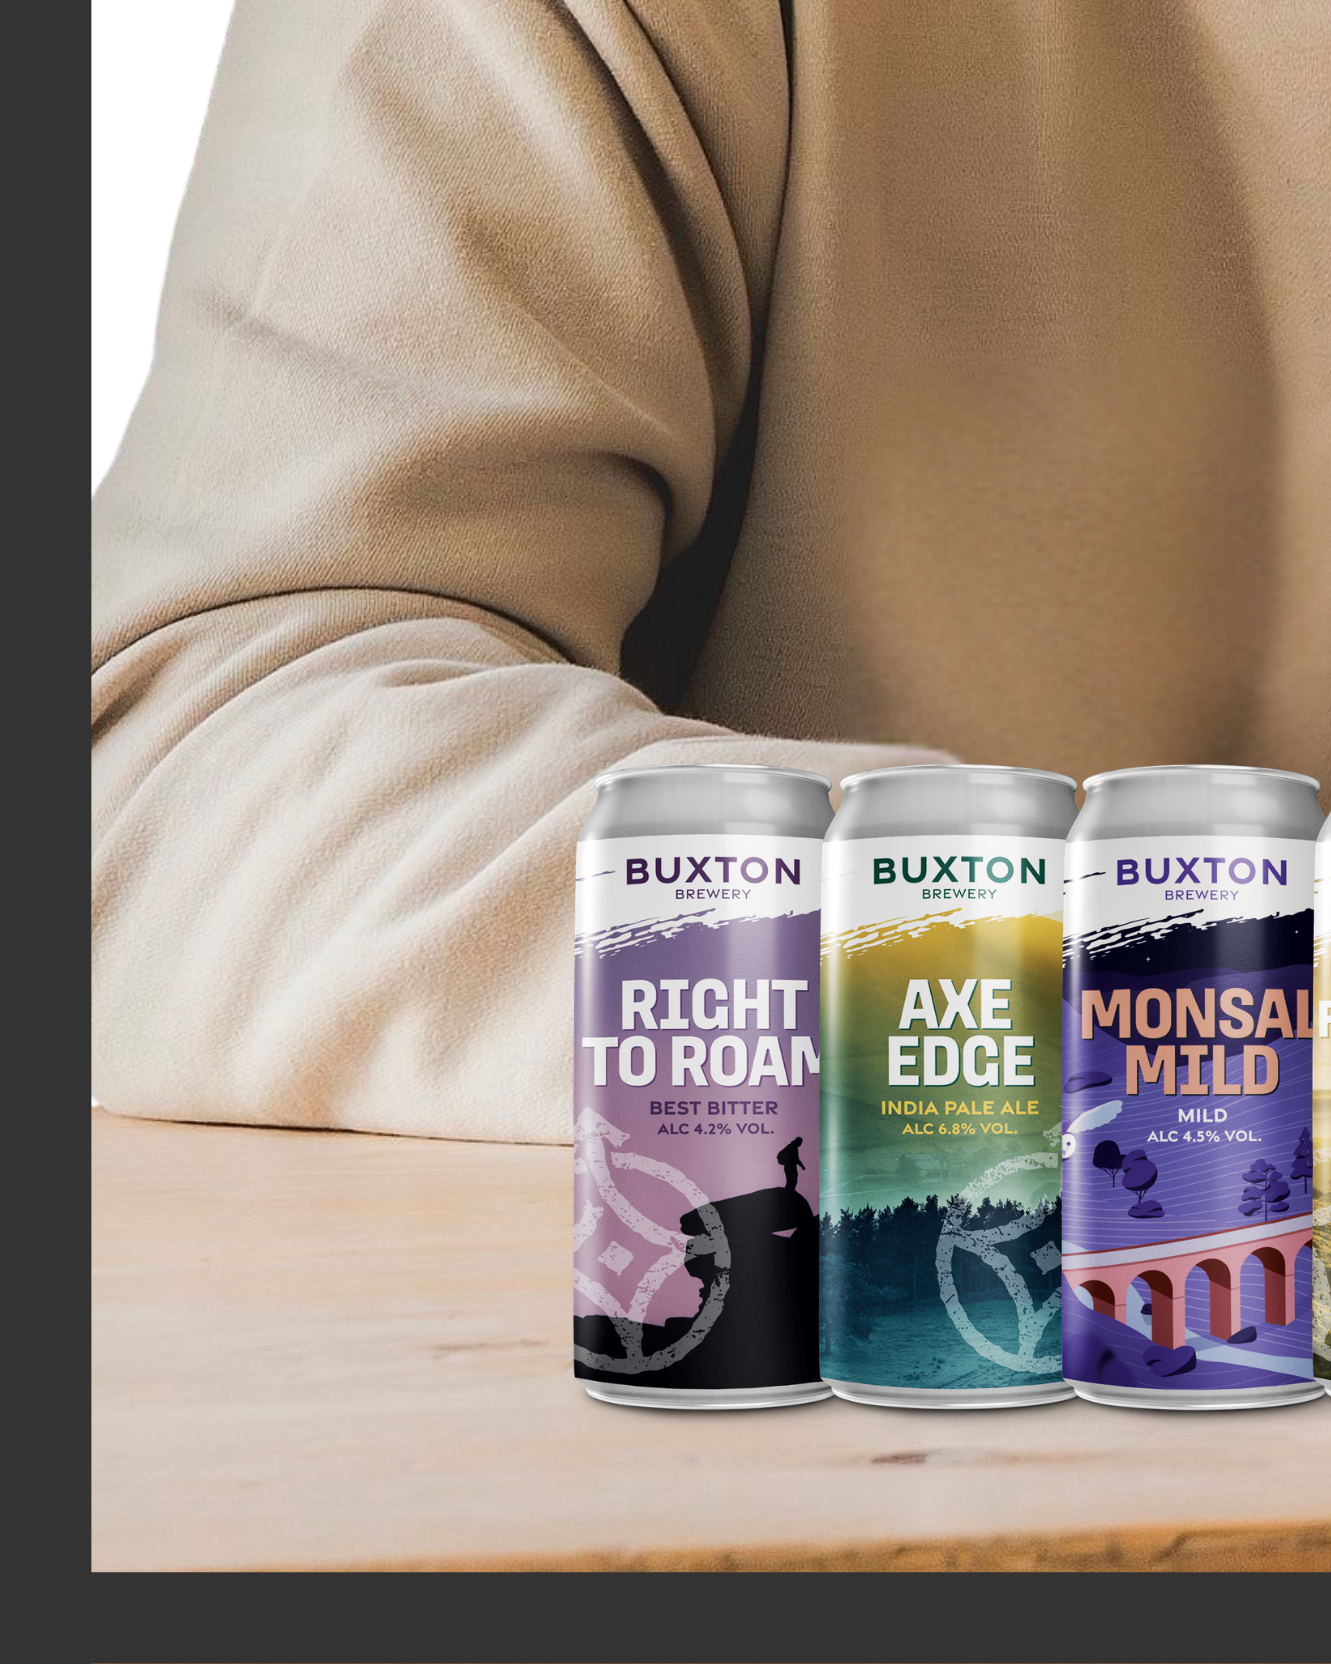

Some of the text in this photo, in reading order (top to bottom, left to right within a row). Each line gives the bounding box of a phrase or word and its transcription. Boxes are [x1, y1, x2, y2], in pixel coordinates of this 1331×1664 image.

[626, 857, 802, 885] BUXTON
[873, 857, 1046, 885] BUXTON
[1116, 857, 1288, 886] BUXTON
[675, 888, 751, 900] BREWERY
[922, 888, 998, 900] BREWERY
[1164, 889, 1239, 901] BREWERY
[622, 978, 809, 1030] RIGHT
[899, 978, 1013, 1031] AXE
[1082, 987, 1313, 1040] MONSAL
[582, 1035, 656, 1087] TO
[888, 1035, 1036, 1088] EDGE
[1126, 1044, 1280, 1096] MILD
[650, 1101, 778, 1115] BEST BITTER
[881, 1100, 1039, 1116] INDIA PALE ALE
[1178, 1108, 1228, 1123] MILD
[657, 1122, 775, 1135] ALC 4.2% VOL.
[902, 1122, 1018, 1135] ALC 6.8% VOL.
[1147, 1130, 1262, 1142] ALC 4.5% VOL.
